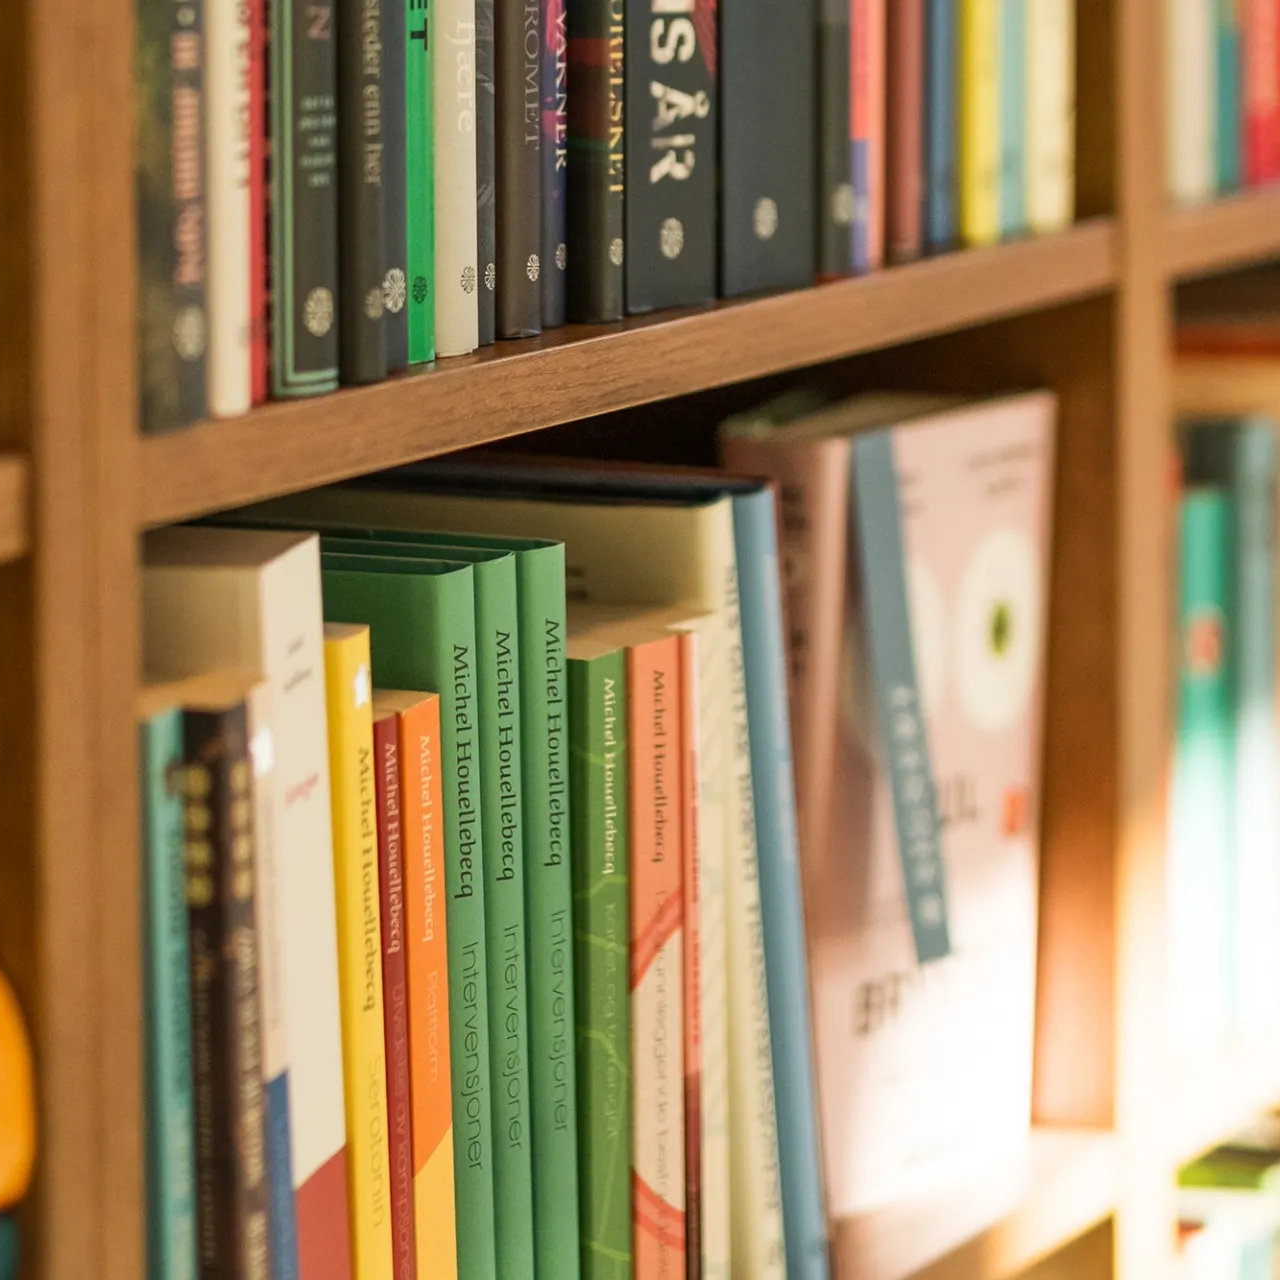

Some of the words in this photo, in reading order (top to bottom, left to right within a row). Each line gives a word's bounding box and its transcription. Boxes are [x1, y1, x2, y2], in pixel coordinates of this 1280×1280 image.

[362, 83, 382, 136] enn
[363, 141, 385, 187] her
[648, 80, 711, 185] ÅR
[452, 643, 473, 734] Michel
[495, 629, 515, 719] Michel
[544, 618, 564, 705] Michel
[602, 677, 617, 747] Michel
[651, 669, 667, 737] Michel
[358, 746, 373, 839] Michel
[384, 742, 398, 818] Michel
[418, 734, 433, 808] Michel
[453, 739, 477, 900] Houellebecq
[495, 724, 518, 883] Houellebecq
[543, 712, 567, 868] Houellebecq
[600, 752, 618, 876] Houellebecq
[651, 743, 669, 864] Houellebecq
[361, 846, 379, 1013] Houellebecq
[387, 821, 402, 955] Houellebecq
[421, 812, 437, 943] Houellebecq
[426, 970, 441, 1084] Plattform
[460, 940, 485, 1171] Intervensjoner
[502, 923, 524, 1150] Intervensjoner
[548, 909, 570, 1133] Intervensjoner
[366, 1052, 386, 1231] Serotonin
